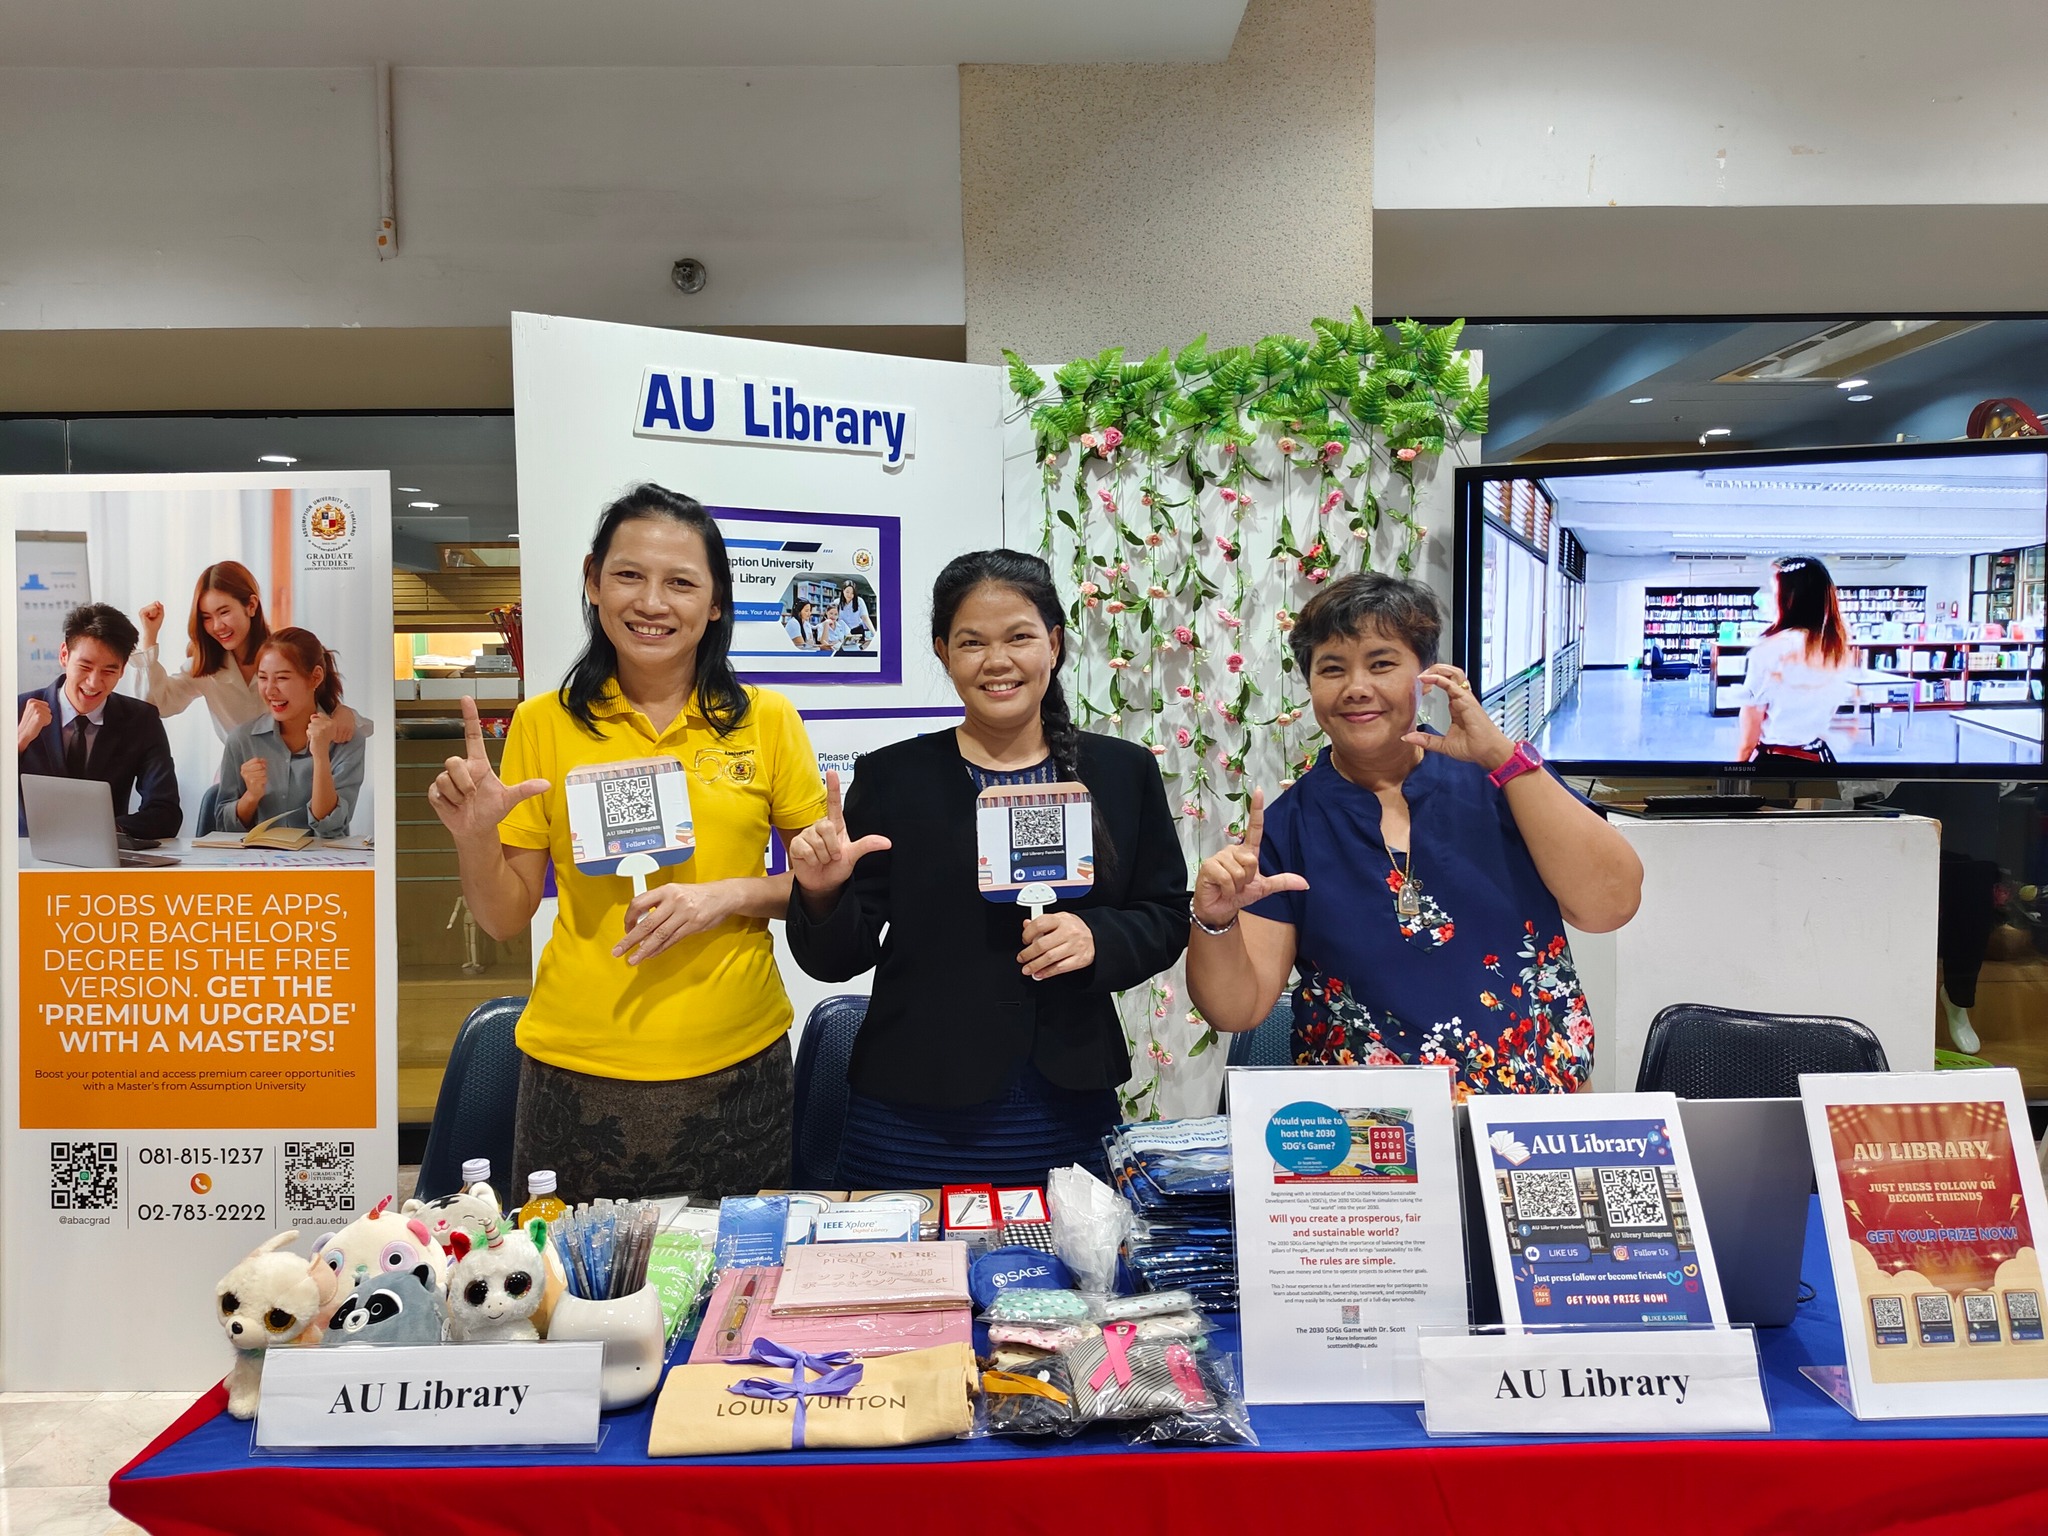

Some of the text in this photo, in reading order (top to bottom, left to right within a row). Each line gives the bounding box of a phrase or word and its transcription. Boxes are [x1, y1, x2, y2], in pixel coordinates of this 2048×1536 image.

[642, 373, 906, 462] AU Library
[313, 496, 343, 505] UNIVERSITY
[762, 558, 814, 571] University
[740, 573, 776, 586] Library
[818, 753, 849, 761] Please
[818, 762, 854, 771] With Us
[635, 825, 661, 833] Instagram
[47, 893, 348, 920] IF JOBS WERE APPS,
[55, 922, 337, 944] YOUR BACHELOR'S
[45, 949, 350, 971] DEGREE IS THE FREE
[60, 976, 333, 998] VERSION. GET THE
[38, 1003, 356, 1025] 'PREMIUM UPGRADE'
[59, 1030, 335, 1053] WITH A MASTER'S!
[35, 1070, 64, 1079] Boost
[66, 1072, 90, 1081] your
[92, 1070, 137, 1081] potential
[140, 1070, 159, 1078] and
[199, 1070, 247, 1080] premium
[285, 1069, 356, 1080] opportunities
[83, 1081, 105, 1090] with
[117, 1082, 159, 1090] Master's
[161, 1082, 187, 1090] from
[190, 1081, 252, 1092] Assumption
[255, 1081, 306, 1092] University
[1272, 1117, 1342, 1125] Would you like to
[1281, 1130, 1336, 1138] host the 2030
[1373, 1131, 1400, 1139] 2030
[1282, 1142, 1335, 1150] SDG's Game?
[1531, 1133, 1648, 1158] AU Library
[1853, 1140, 1990, 1161] AU LIBRARY
[139, 1148, 264, 1165] 081-815-1237
[1375, 1152, 1402, 1160] GAME
[1869, 1180, 1996, 1192] JUST PRESS FOLLOW OR
[1888, 1192, 1983, 1203] BECOME FRIENDS
[138, 1204, 266, 1221] 02-783-2222
[1290, 1216, 1306, 1224] you
[1349, 1216, 1403, 1224] prosperous,
[1406, 1213, 1421, 1222] fair
[58, 1215, 110, 1226] @abacgrad
[292, 1217, 348, 1226] grad.au.edu
[824, 1221, 876, 1230] IEEE Xplore
[1293, 1228, 1399, 1237] and sustainable world?
[1867, 1227, 2018, 1243] GET YOUR PRIZE NOW!
[1549, 1249, 1567, 1257] LIKE
[1634, 1249, 1657, 1257] Follow
[1300, 1257, 1317, 1265] The
[1320, 1257, 1342, 1265] rules
[1363, 1256, 1396, 1266] simple.
[1007, 1266, 1050, 1282] SAGE
[1534, 1271, 1667, 1284] Just press follow or become friends
[1566, 1294, 1668, 1305] GET YOUR PRIZE NOW!
[1495, 1368, 1690, 1405] AU Library
[328, 1380, 530, 1415] AU Library
[717, 1394, 906, 1417] LOUIS VUITTON
